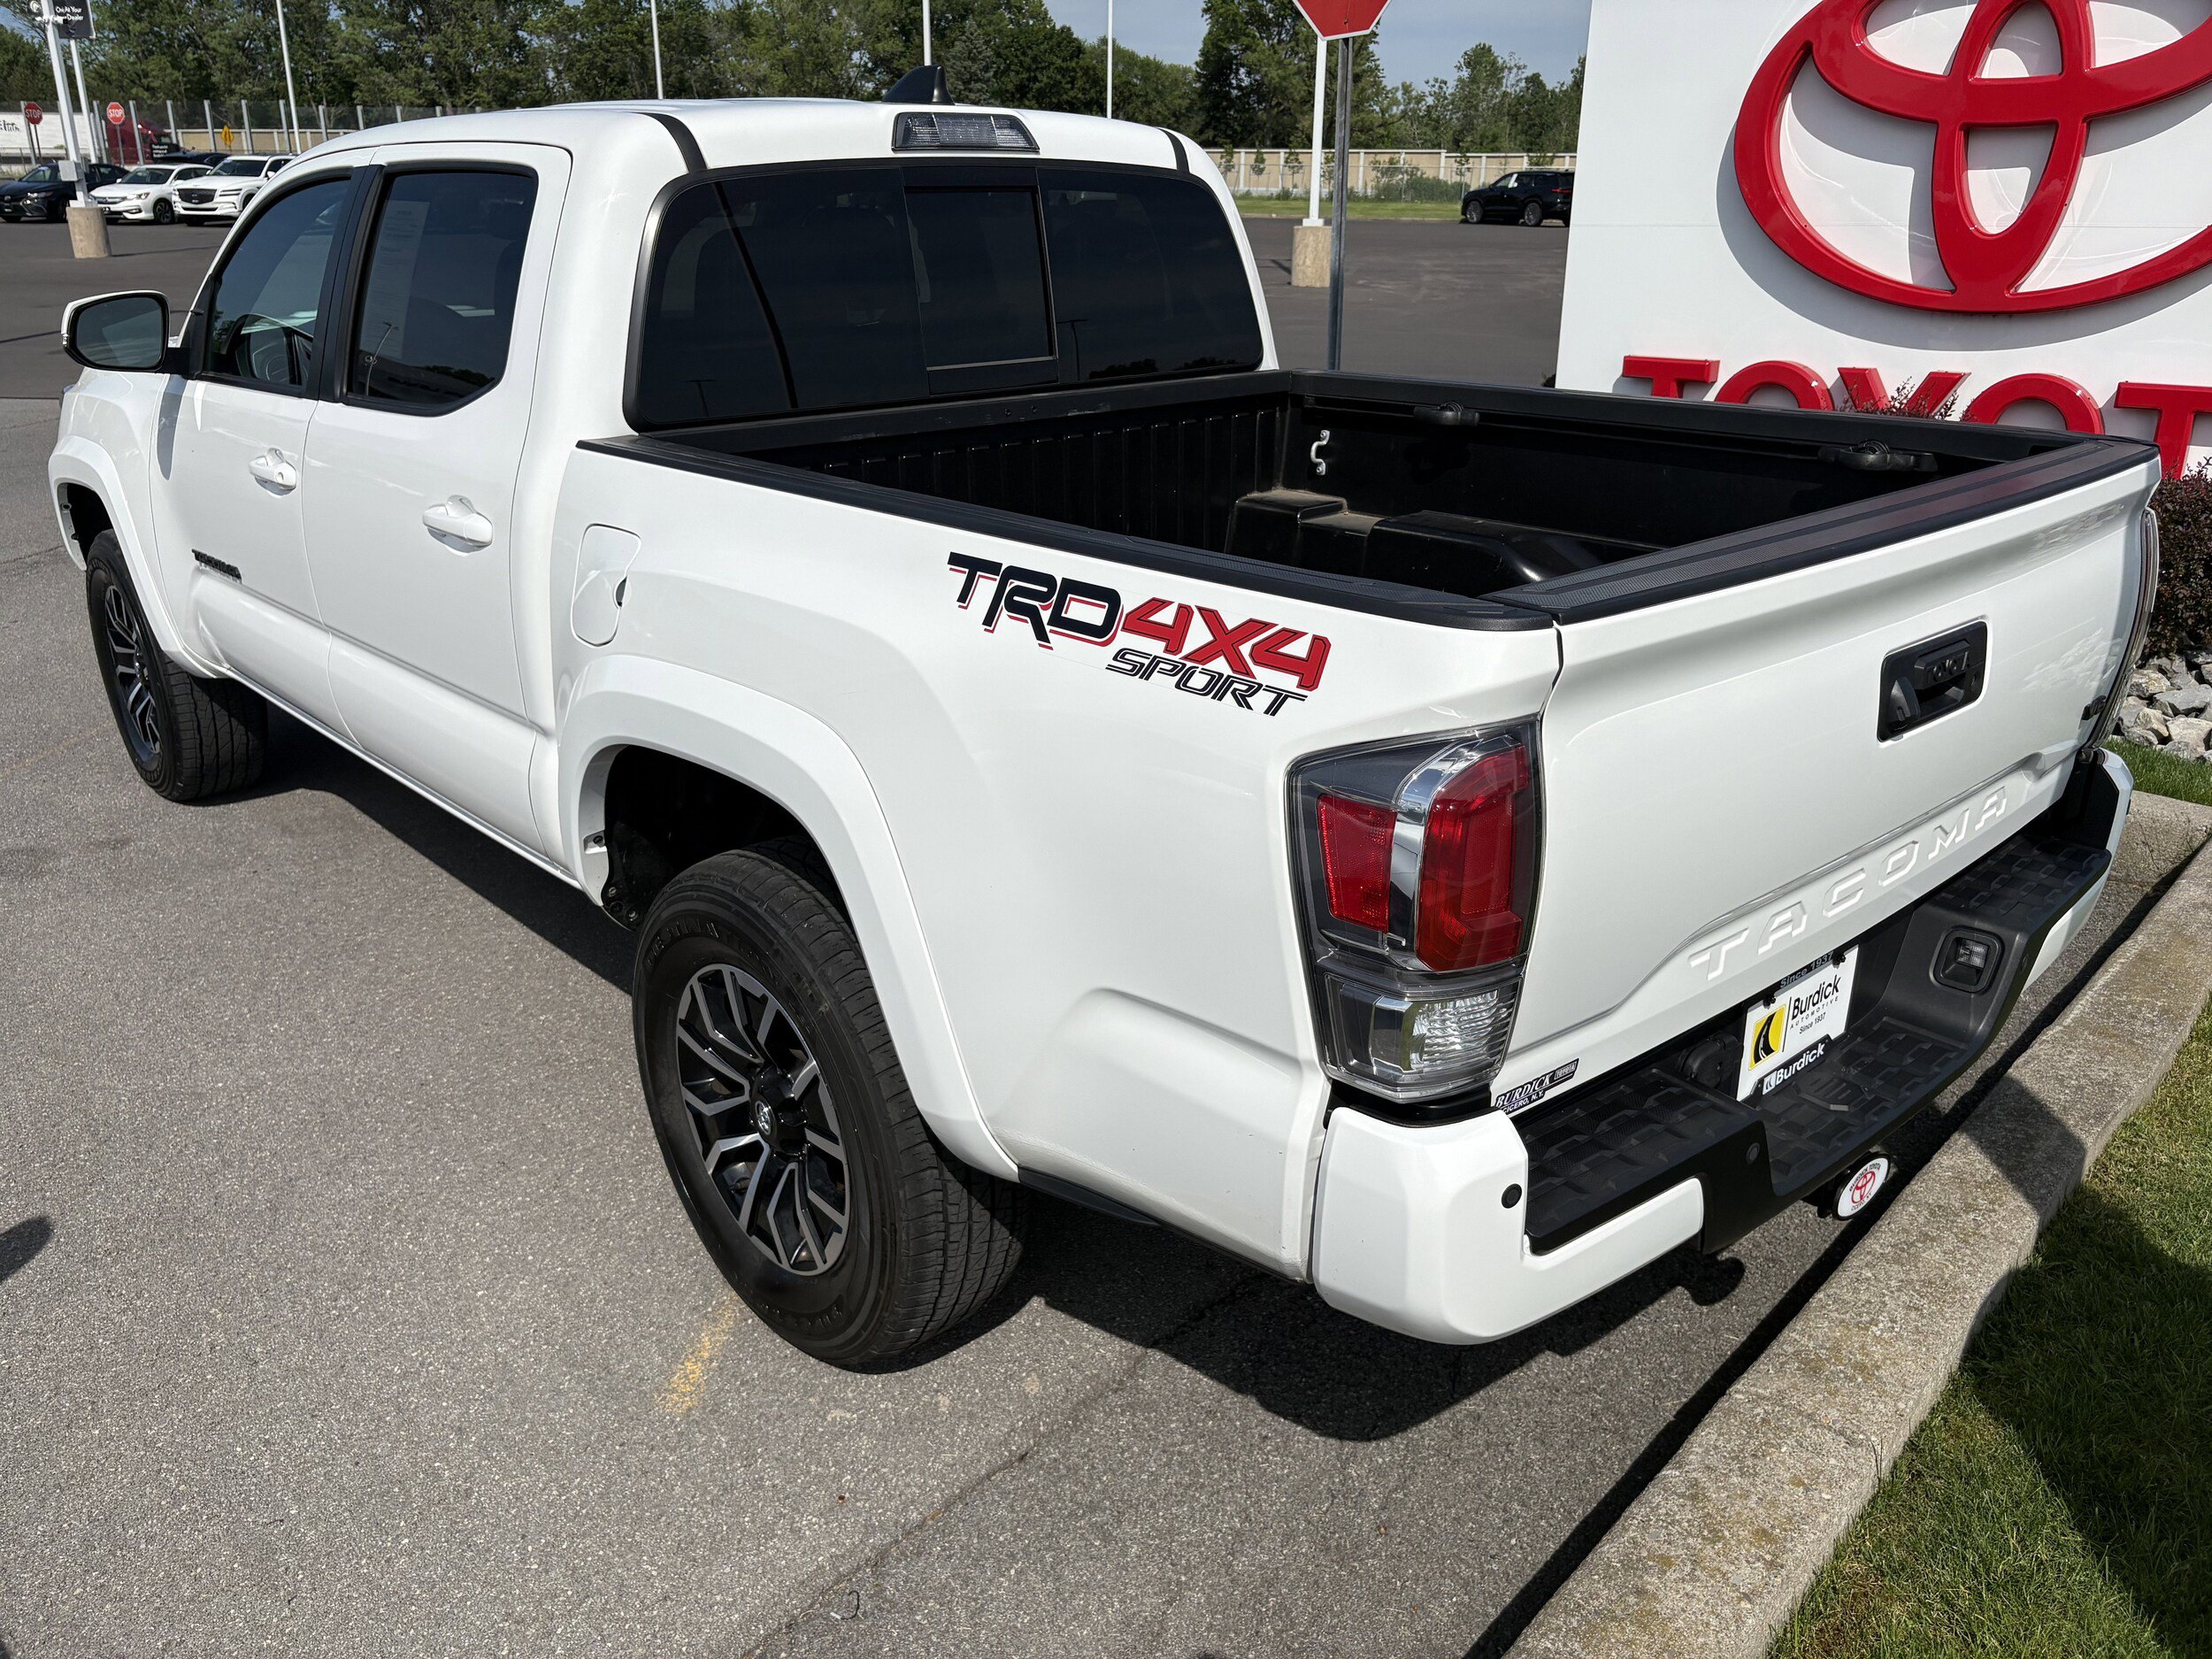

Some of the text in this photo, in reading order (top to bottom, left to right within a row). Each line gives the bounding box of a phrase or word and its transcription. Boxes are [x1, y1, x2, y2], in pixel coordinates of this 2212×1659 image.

[26, 109, 42, 118] STOP
[1105, 647, 1308, 717] SPORT
[1689, 786, 2007, 980] TACOMA
[1779, 951, 1833, 988] Since 1937
[1790, 995, 1839, 1030] AUTOMOTIVE
[1792, 974, 1841, 1020] Burdick
[1799, 1011, 1826, 1034] Since 1937
[1495, 1064, 1575, 1108] BURDICK TOYOTA
[1776, 1042, 1825, 1086] Burdick
